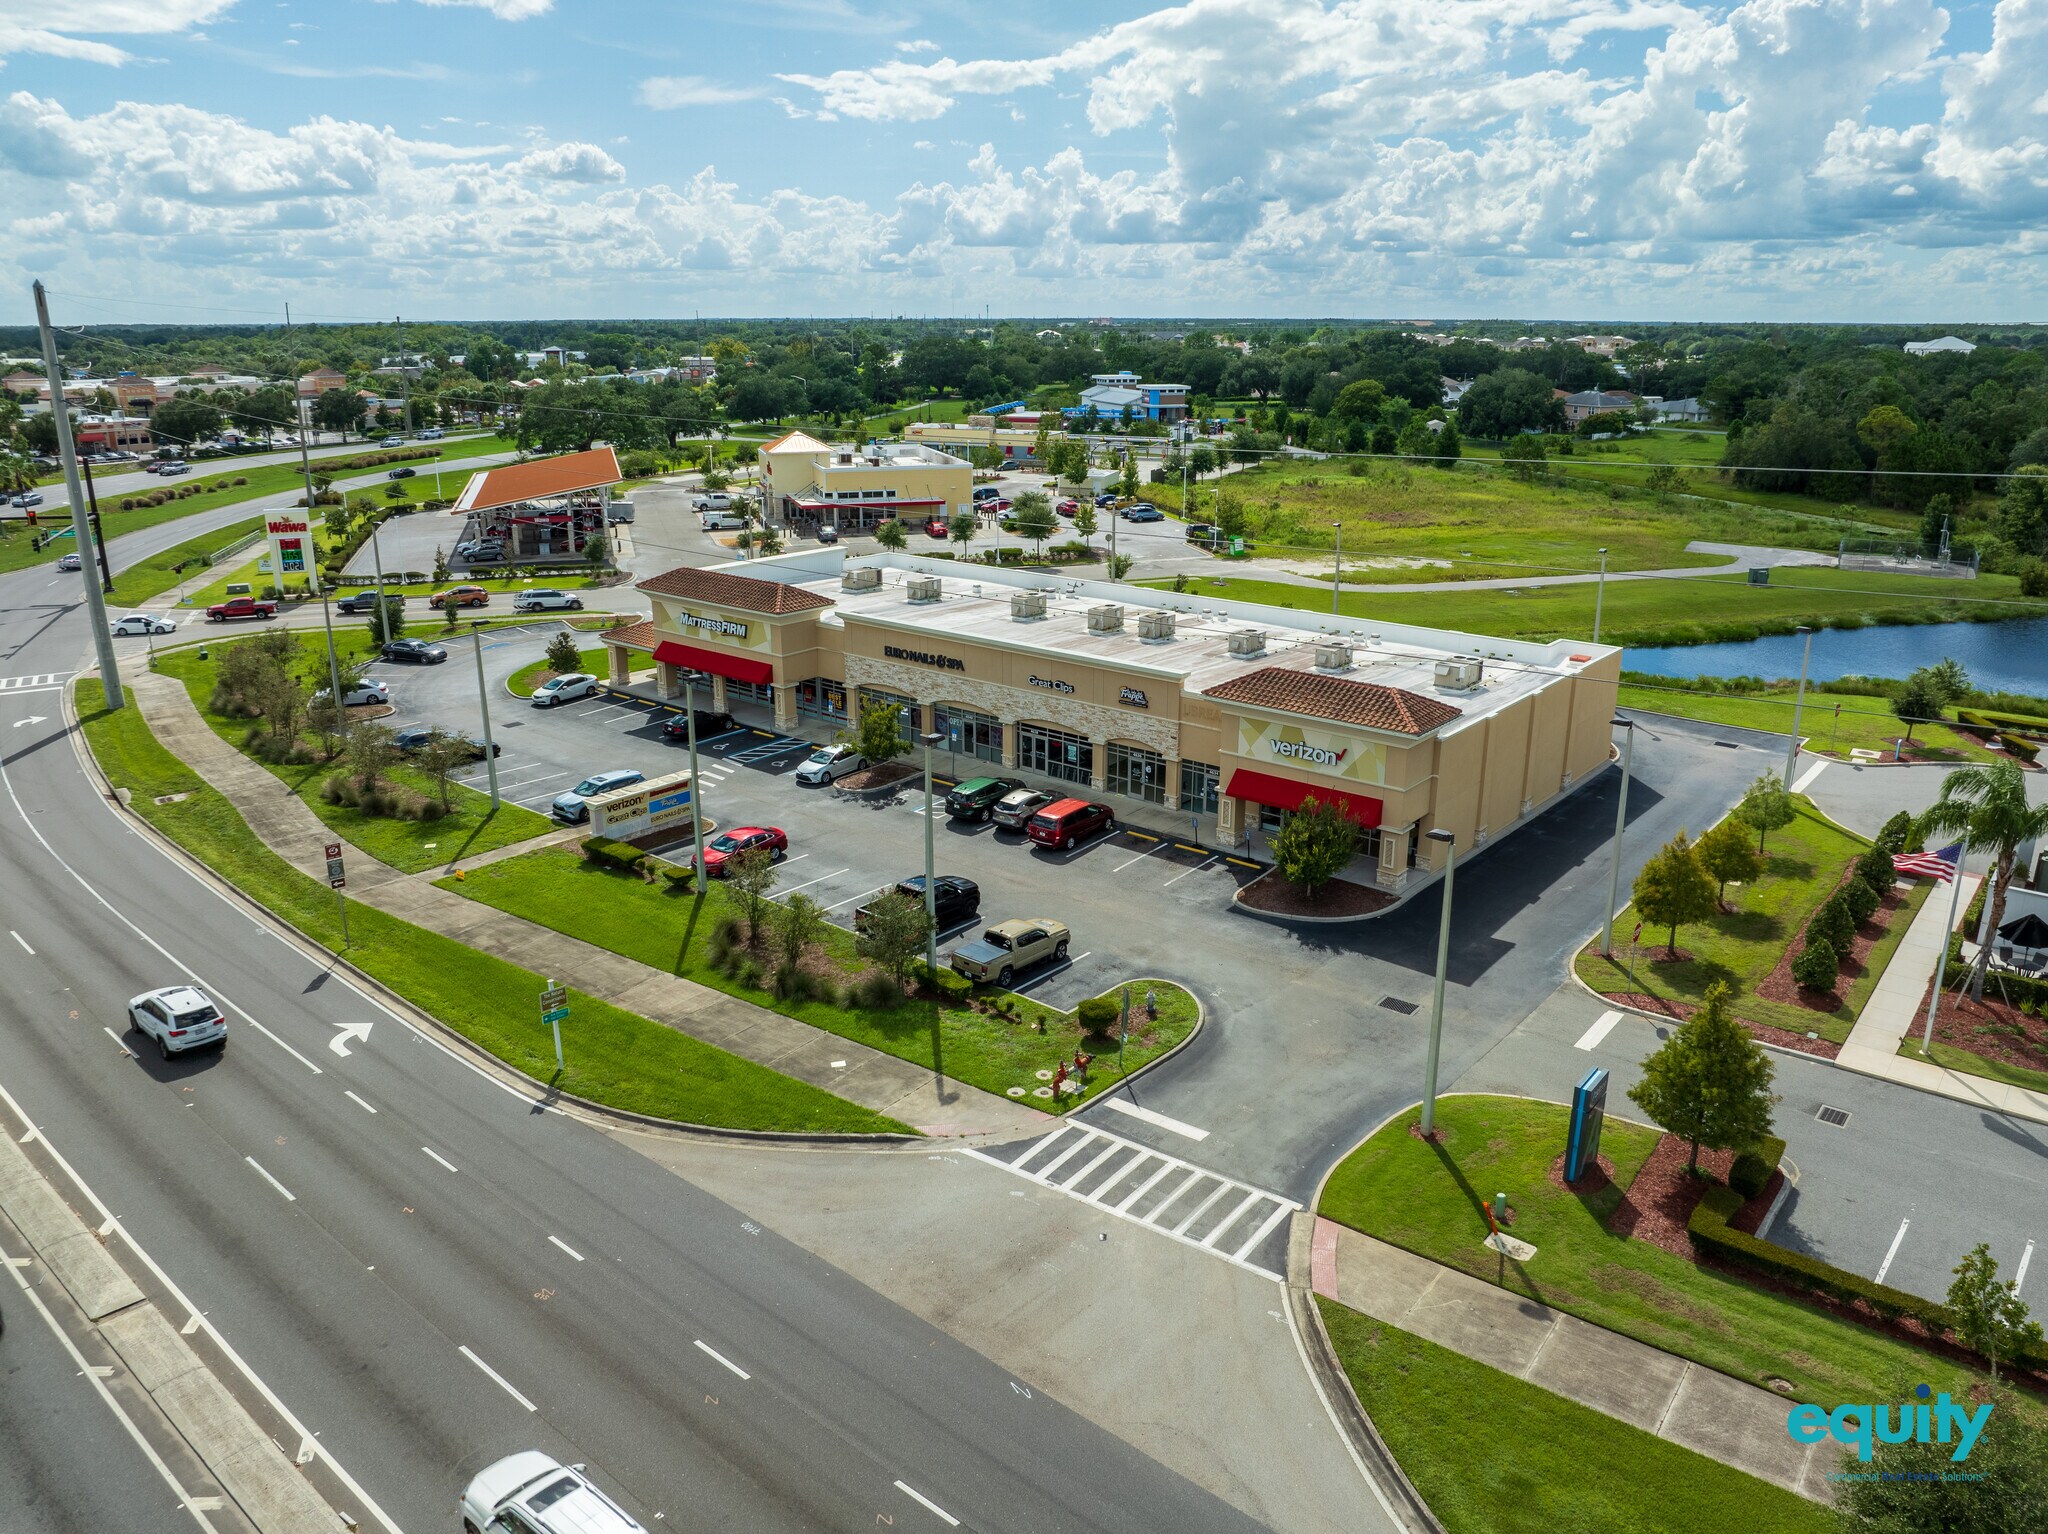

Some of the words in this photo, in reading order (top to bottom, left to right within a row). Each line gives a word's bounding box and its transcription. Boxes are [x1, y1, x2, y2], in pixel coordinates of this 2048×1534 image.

[268, 522, 307, 533] Wawa
[884, 645, 909, 660] EURO
[909, 650, 935, 665] NAILS
[946, 658, 965, 671] SPA
[1027, 675, 1053, 689] Great
[1053, 680, 1075, 694] Clips
[1270, 739, 1338, 766] verizon
[607, 796, 641, 813] verizon
[607, 812, 629, 824] Great
[630, 807, 647, 818] Clips
[651, 814, 664, 823] EURO
[664, 809, 676, 818] NAILS
